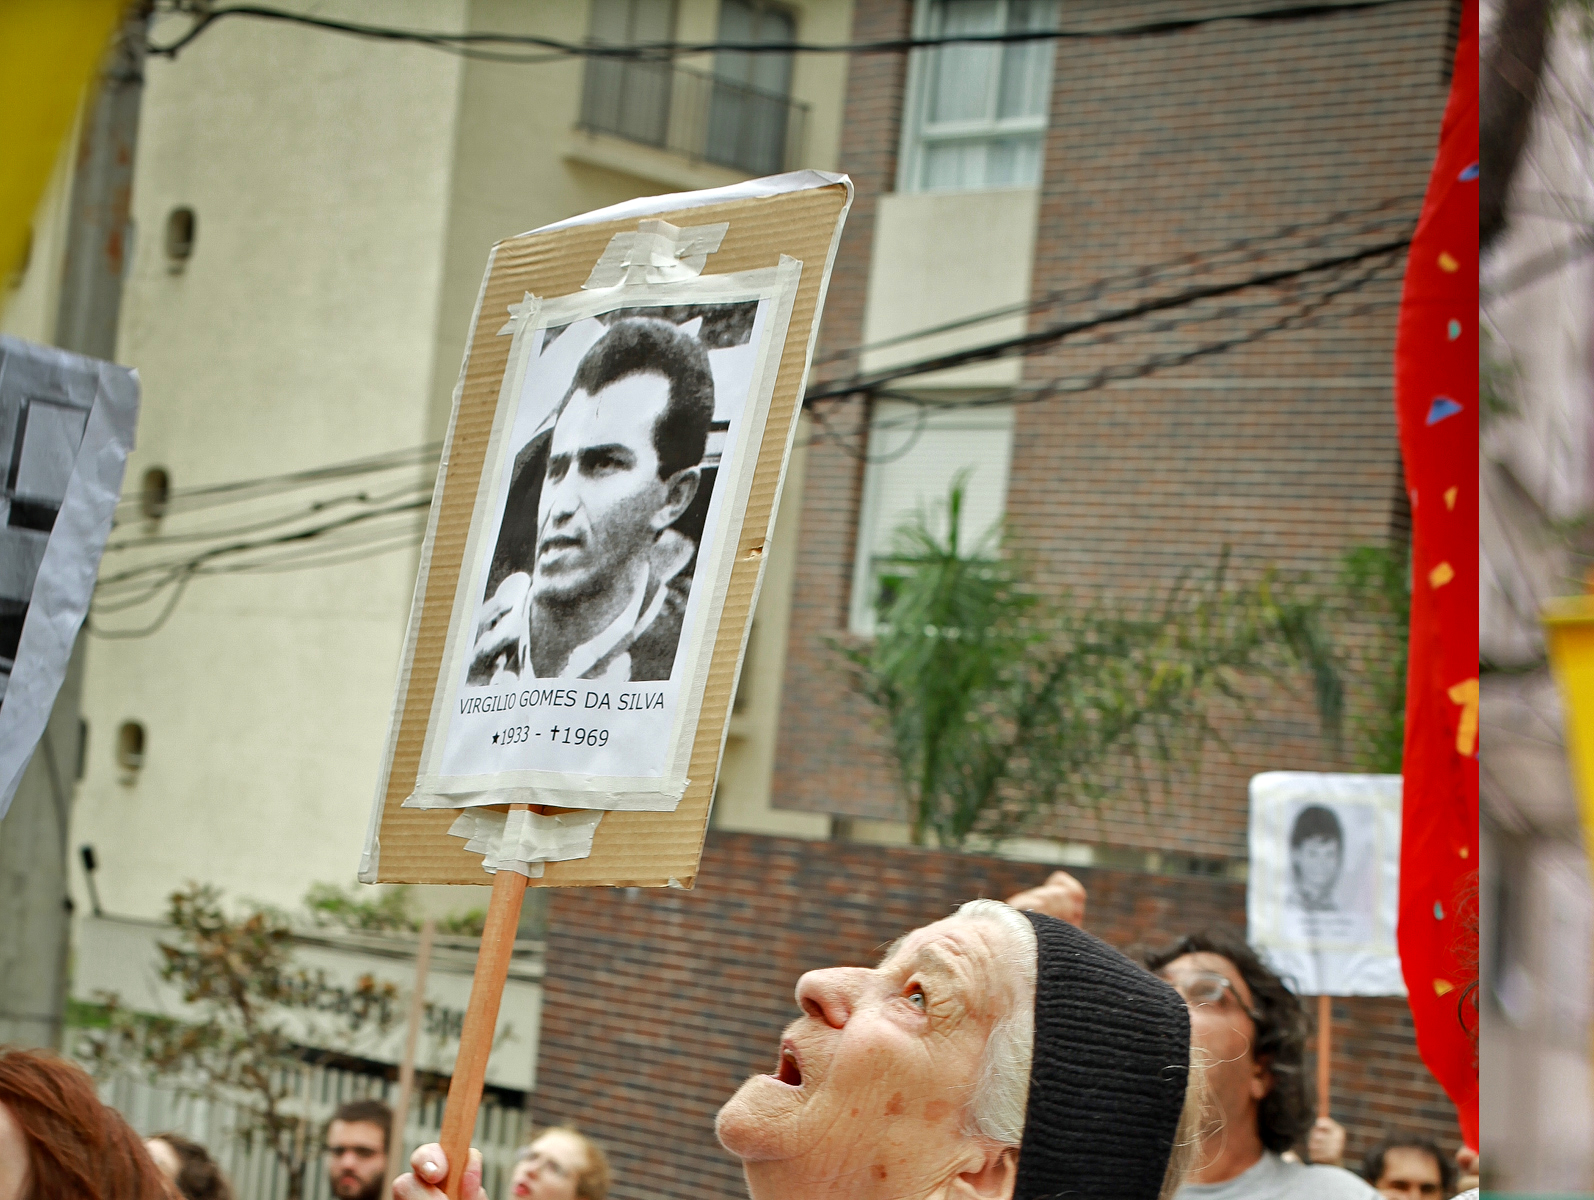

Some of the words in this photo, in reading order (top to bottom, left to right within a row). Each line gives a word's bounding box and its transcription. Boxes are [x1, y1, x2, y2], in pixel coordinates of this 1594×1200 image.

[460, 693, 516, 715] VIRGILIO
[519, 689, 577, 708] GOMES
[584, 691, 611, 710] DA
[617, 692, 665, 711] SILVA
